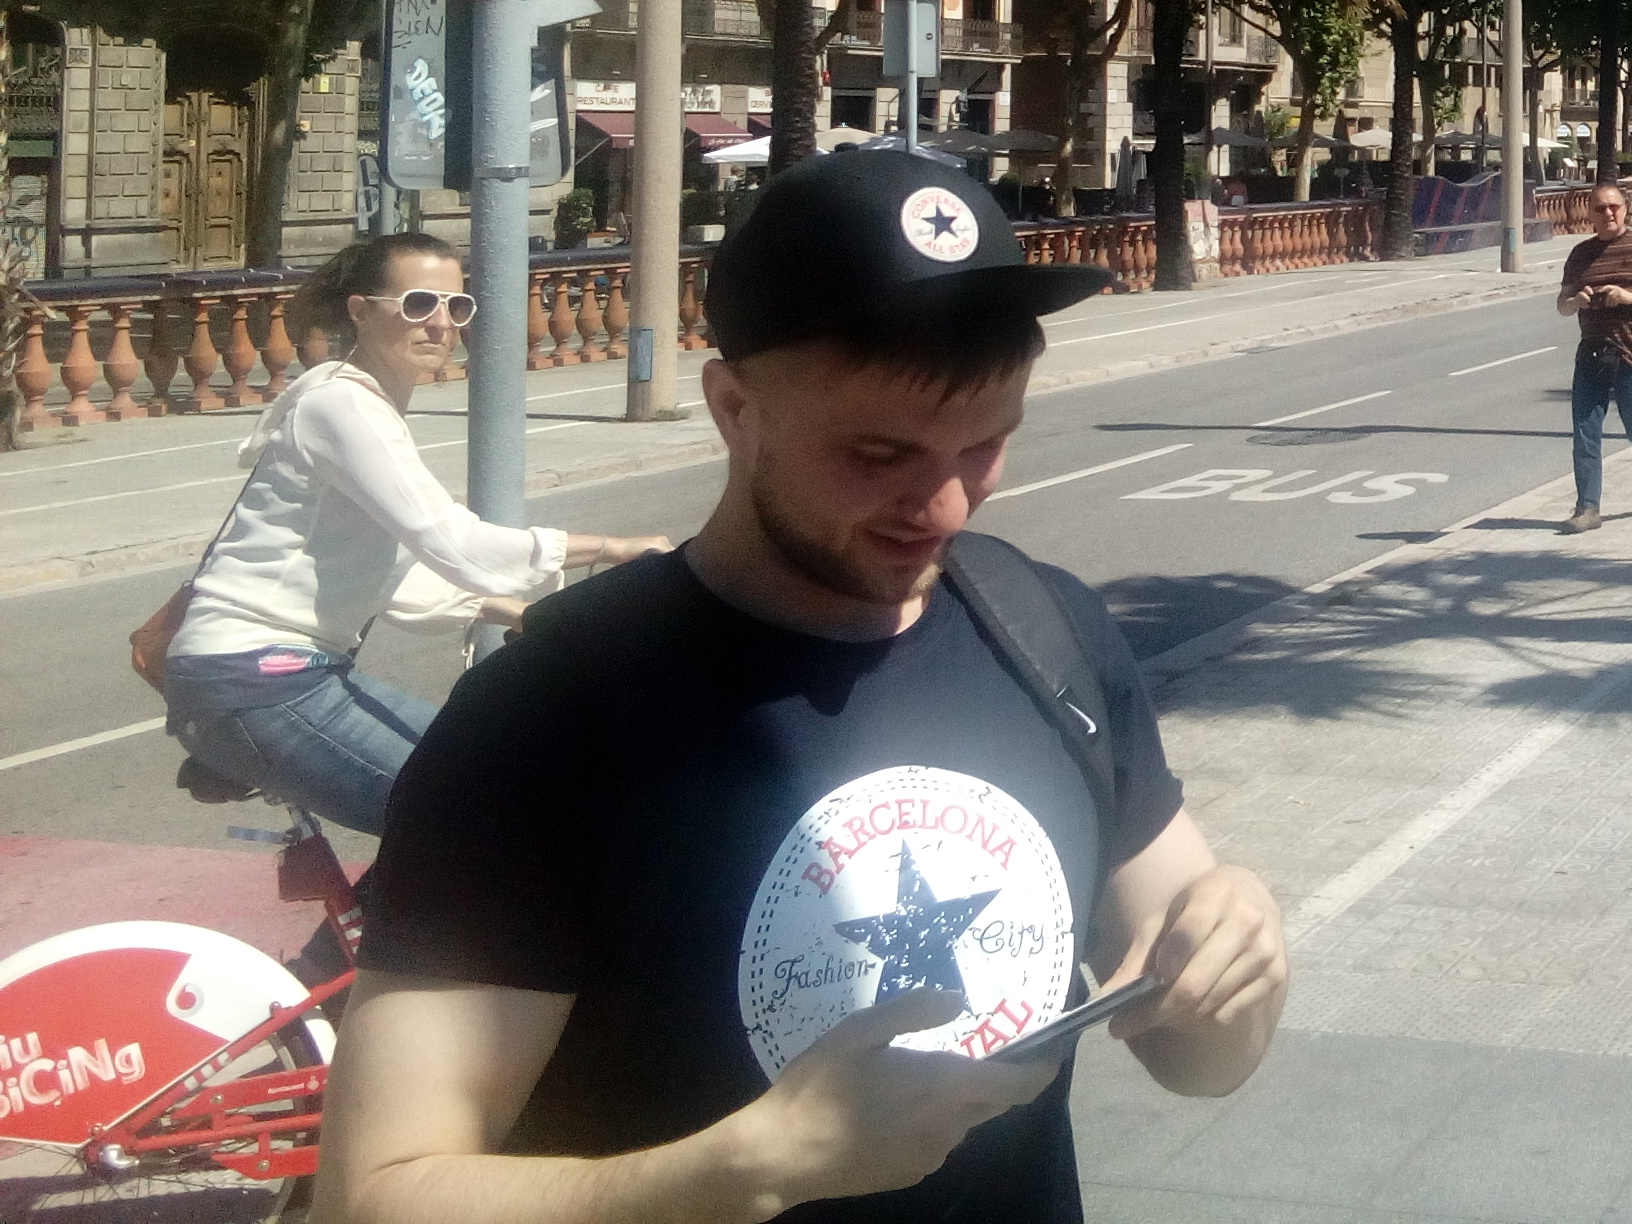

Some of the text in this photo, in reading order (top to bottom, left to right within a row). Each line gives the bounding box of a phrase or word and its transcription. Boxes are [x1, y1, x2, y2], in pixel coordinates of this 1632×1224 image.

[577, 96, 636, 106] RESTAURANT
[911, 195, 962, 219] CONVERSE
[924, 237, 971, 254] ALL STAR
[1119, 469, 1450, 504] BUS
[801, 798, 1018, 896] BARCELONA
[772, 920, 1045, 999] Fashion City
